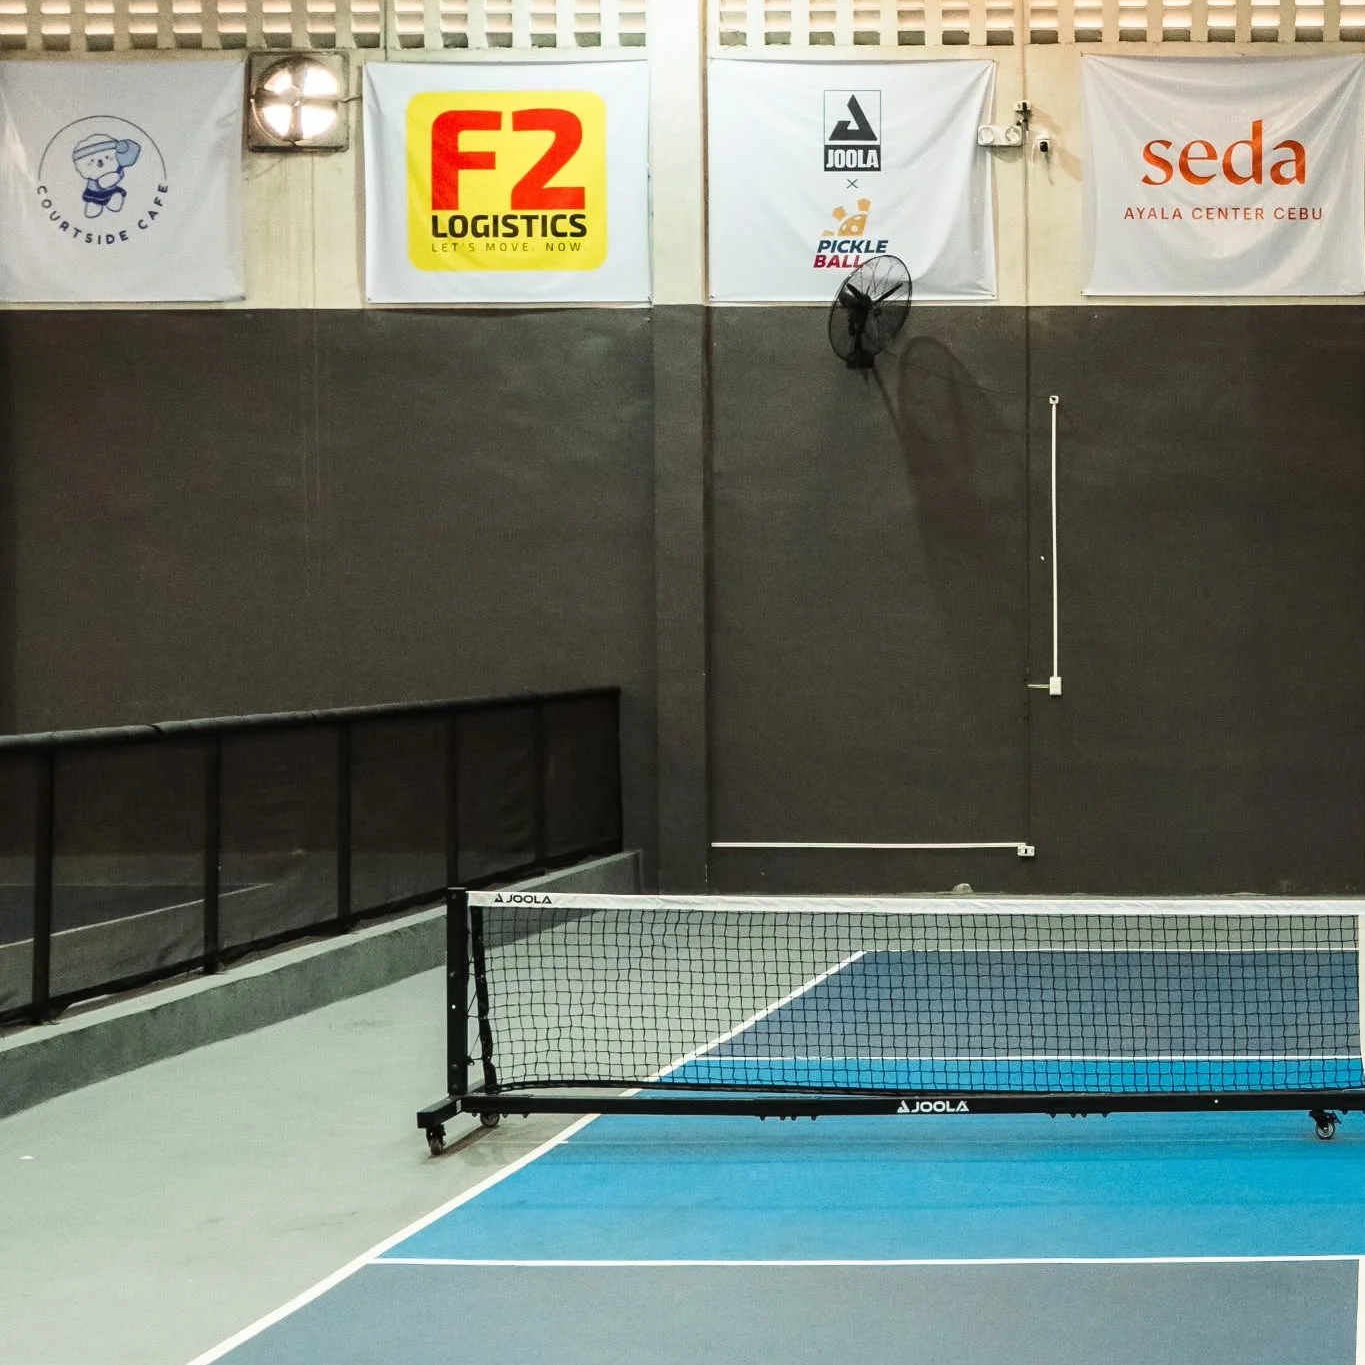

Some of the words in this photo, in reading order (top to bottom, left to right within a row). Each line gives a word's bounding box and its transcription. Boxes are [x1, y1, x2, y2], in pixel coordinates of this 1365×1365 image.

[826, 149, 879, 168] JOOLA
[1141, 119, 1306, 185] seda
[432, 108, 585, 211] F2
[37, 185, 129, 245] COURTSIDE
[137, 184, 169, 229] CAFE
[1124, 207, 1183, 220] AYALA
[1191, 207, 1265, 220] CENTER
[1273, 207, 1323, 220] CEBU
[432, 213, 587, 238] LOGISTICS
[431, 242, 475, 252] LET'S
[816, 240, 889, 253] PICKLE
[813, 255, 864, 268] BALL
[506, 894, 552, 904] JOOLA
[911, 1100, 970, 1113] JOOLA
